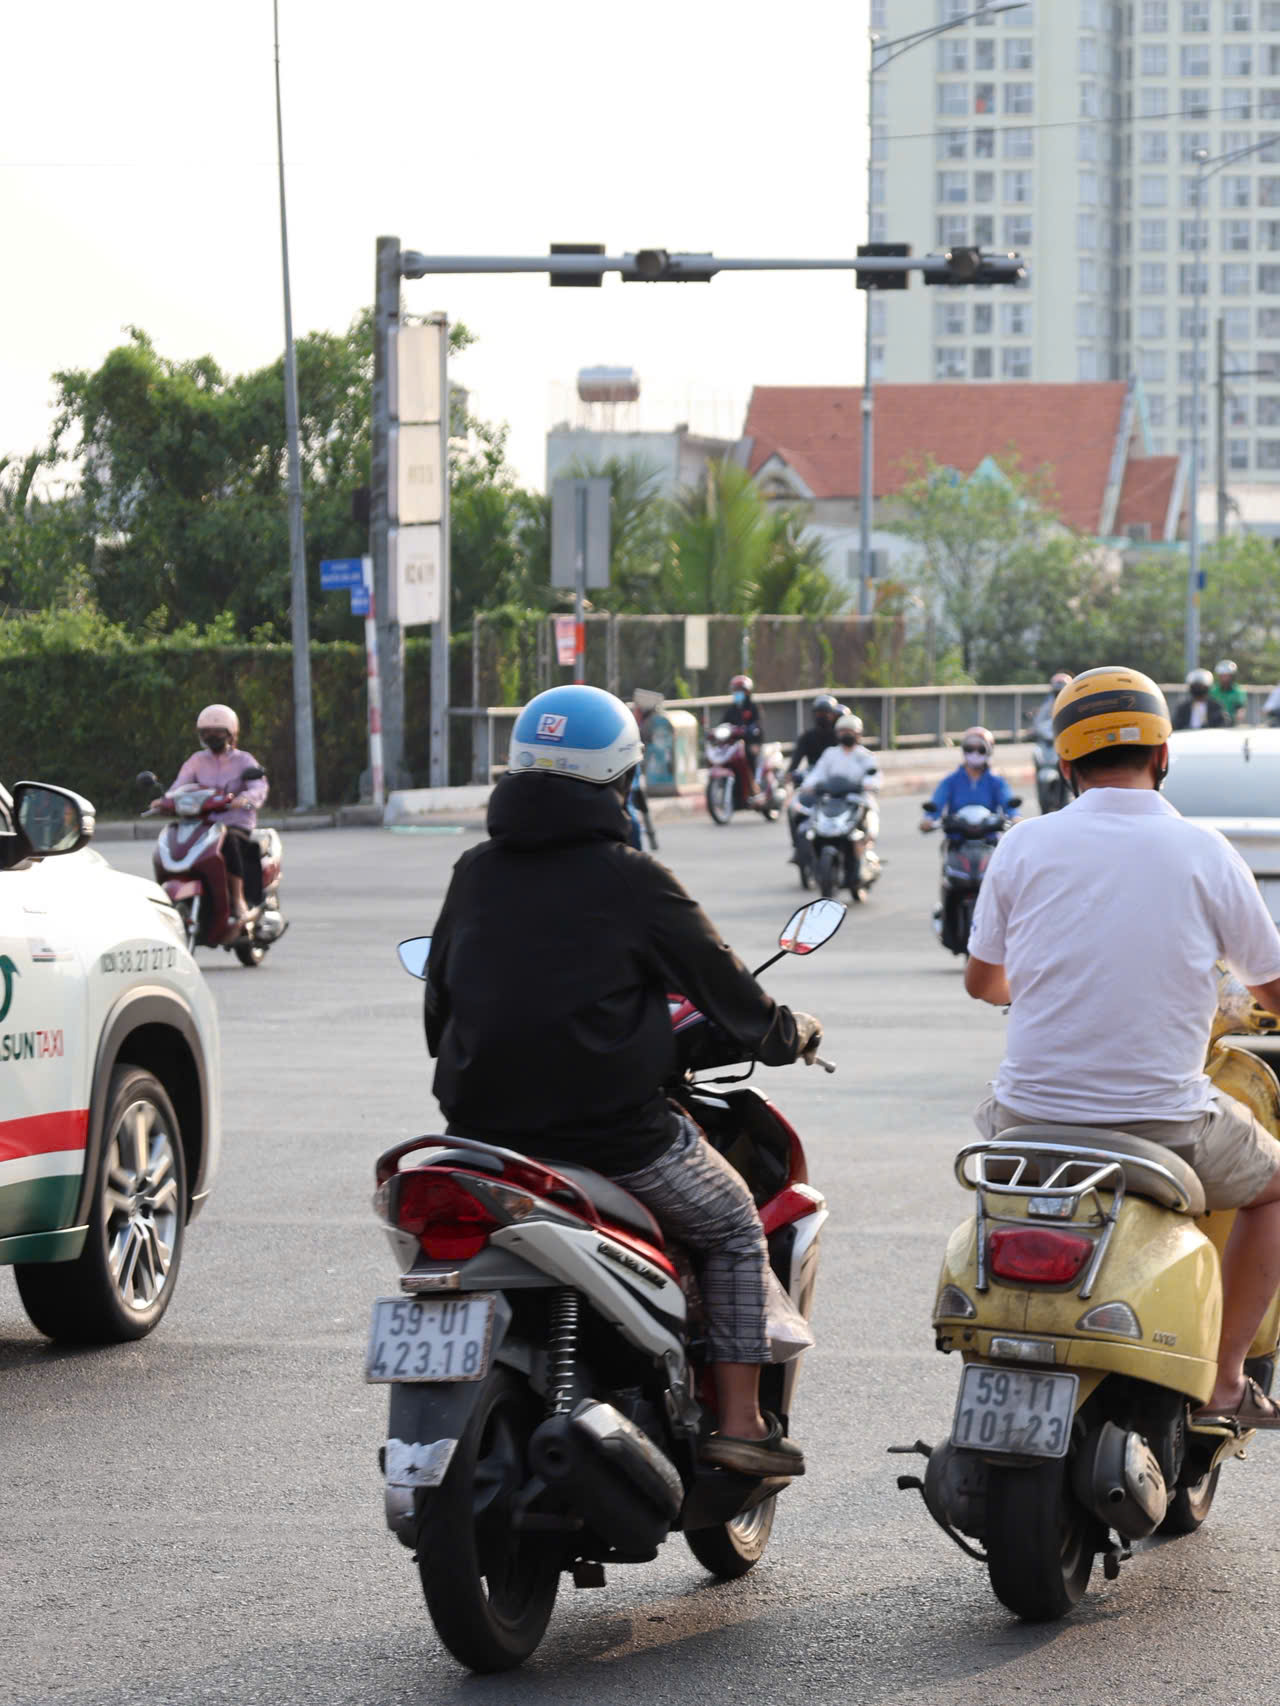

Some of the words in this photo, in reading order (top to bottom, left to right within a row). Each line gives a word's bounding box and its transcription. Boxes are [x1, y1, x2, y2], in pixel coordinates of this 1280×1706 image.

[389, 1302, 470, 1336] 59-U1
[372, 1340, 480, 1376] 423.18
[975, 1371, 1056, 1413] 59-T1
